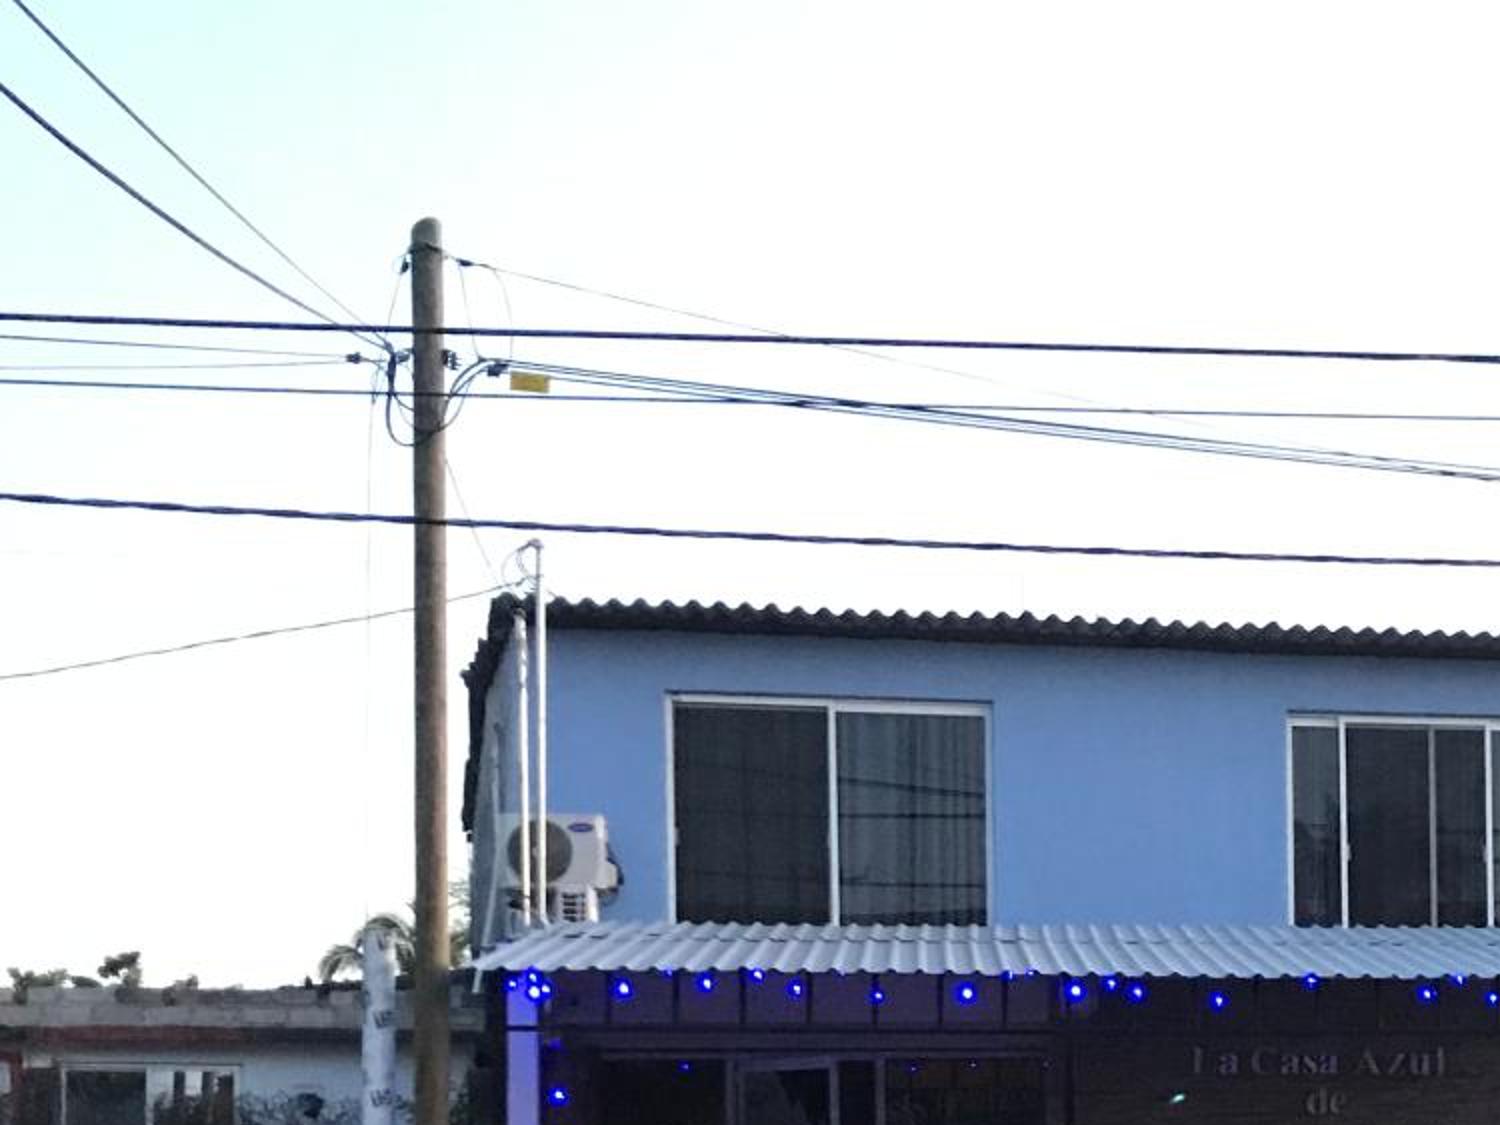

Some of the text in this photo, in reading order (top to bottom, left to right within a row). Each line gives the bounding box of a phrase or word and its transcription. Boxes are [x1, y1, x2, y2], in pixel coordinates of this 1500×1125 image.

[1193, 1046, 1445, 1074] La Casa Azul
[1306, 1088, 1346, 1115] de
